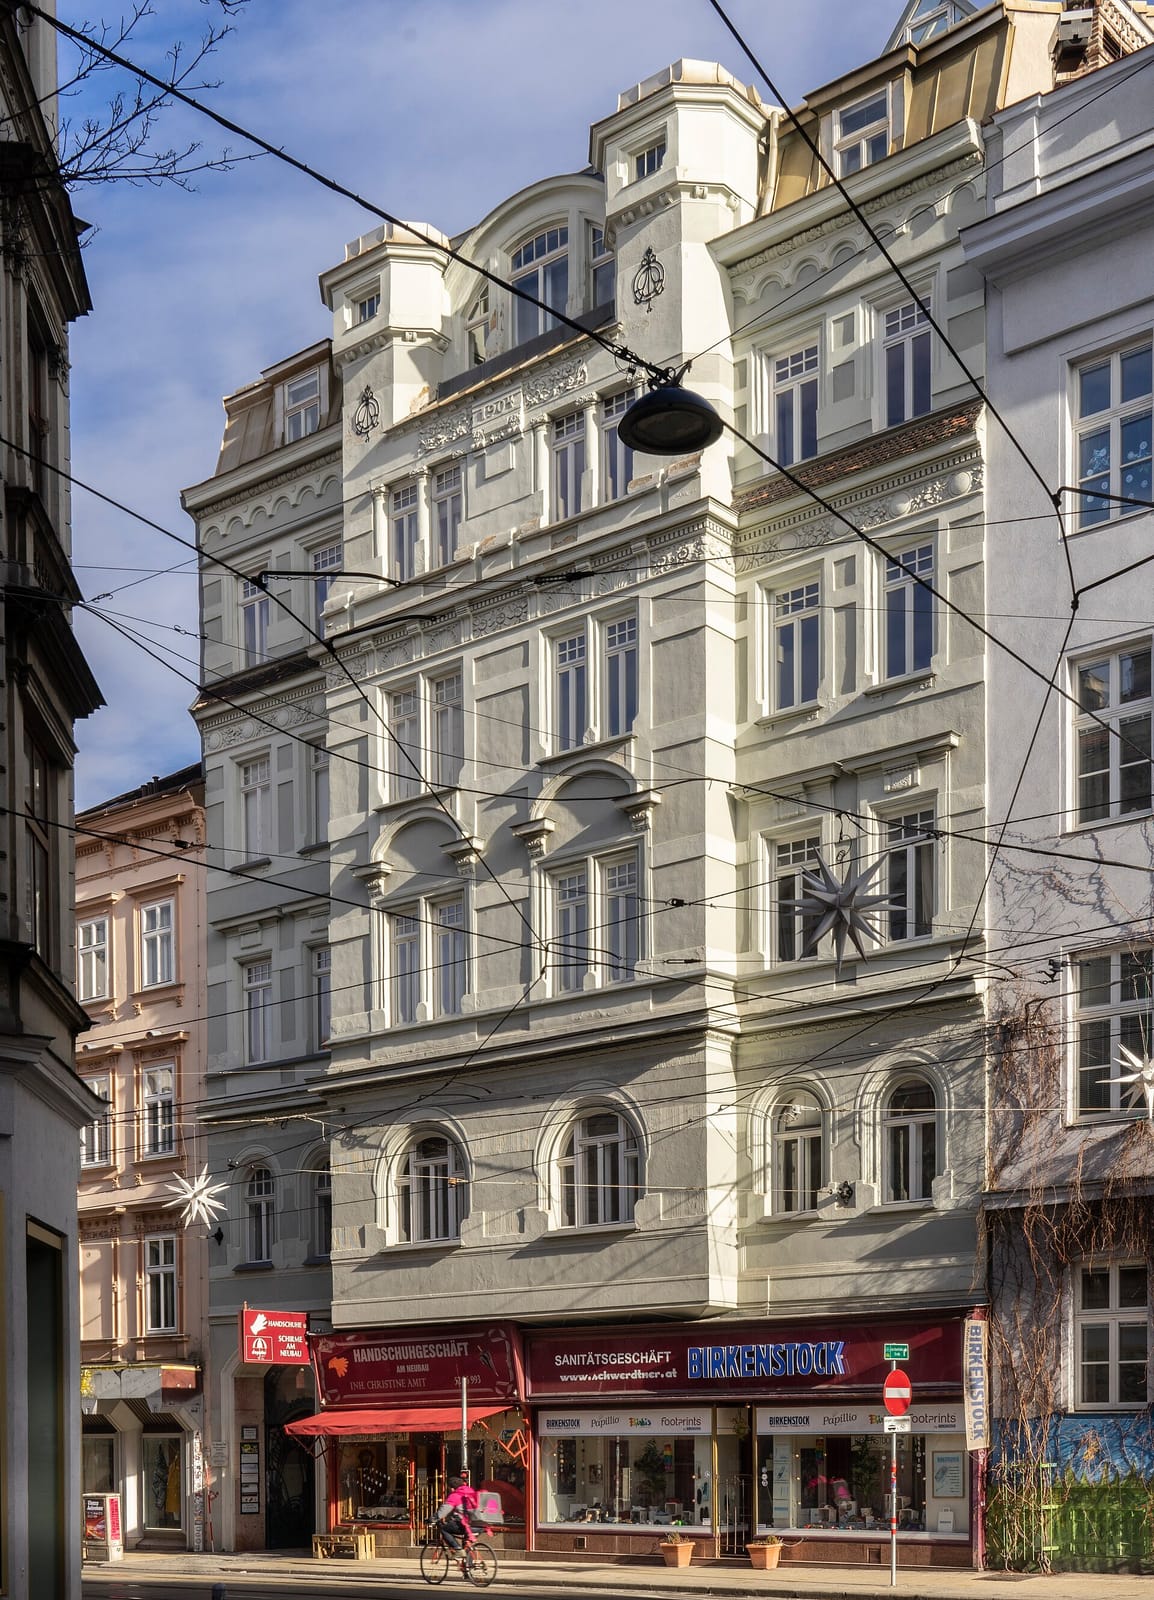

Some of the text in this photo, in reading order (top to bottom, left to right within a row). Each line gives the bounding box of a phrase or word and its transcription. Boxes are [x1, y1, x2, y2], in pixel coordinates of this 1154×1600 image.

[278, 1335, 303, 1343] SCHIRME
[353, 1340, 469, 1363] HANDSCHUHGESCHÄFT
[554, 1349, 672, 1366] SANITÄTSGESCHÄFT
[687, 1341, 845, 1379] BIRKENSTOCK
[396, 1364, 430, 1374] AM NEUBAU
[559, 1368, 678, 1382] www.schwerdtner.at
[366, 1378, 407, 1390] CHRISTINE
[407, 1377, 427, 1388] AMIT
[968, 1325, 985, 1441] BIRKENSTOCK
[546, 1419, 580, 1428] BIRKENSTOCK
[591, 1416, 620, 1428] Papillio
[769, 1416, 810, 1425] BIRKENSTOCK
[823, 1413, 858, 1426] Papillio
